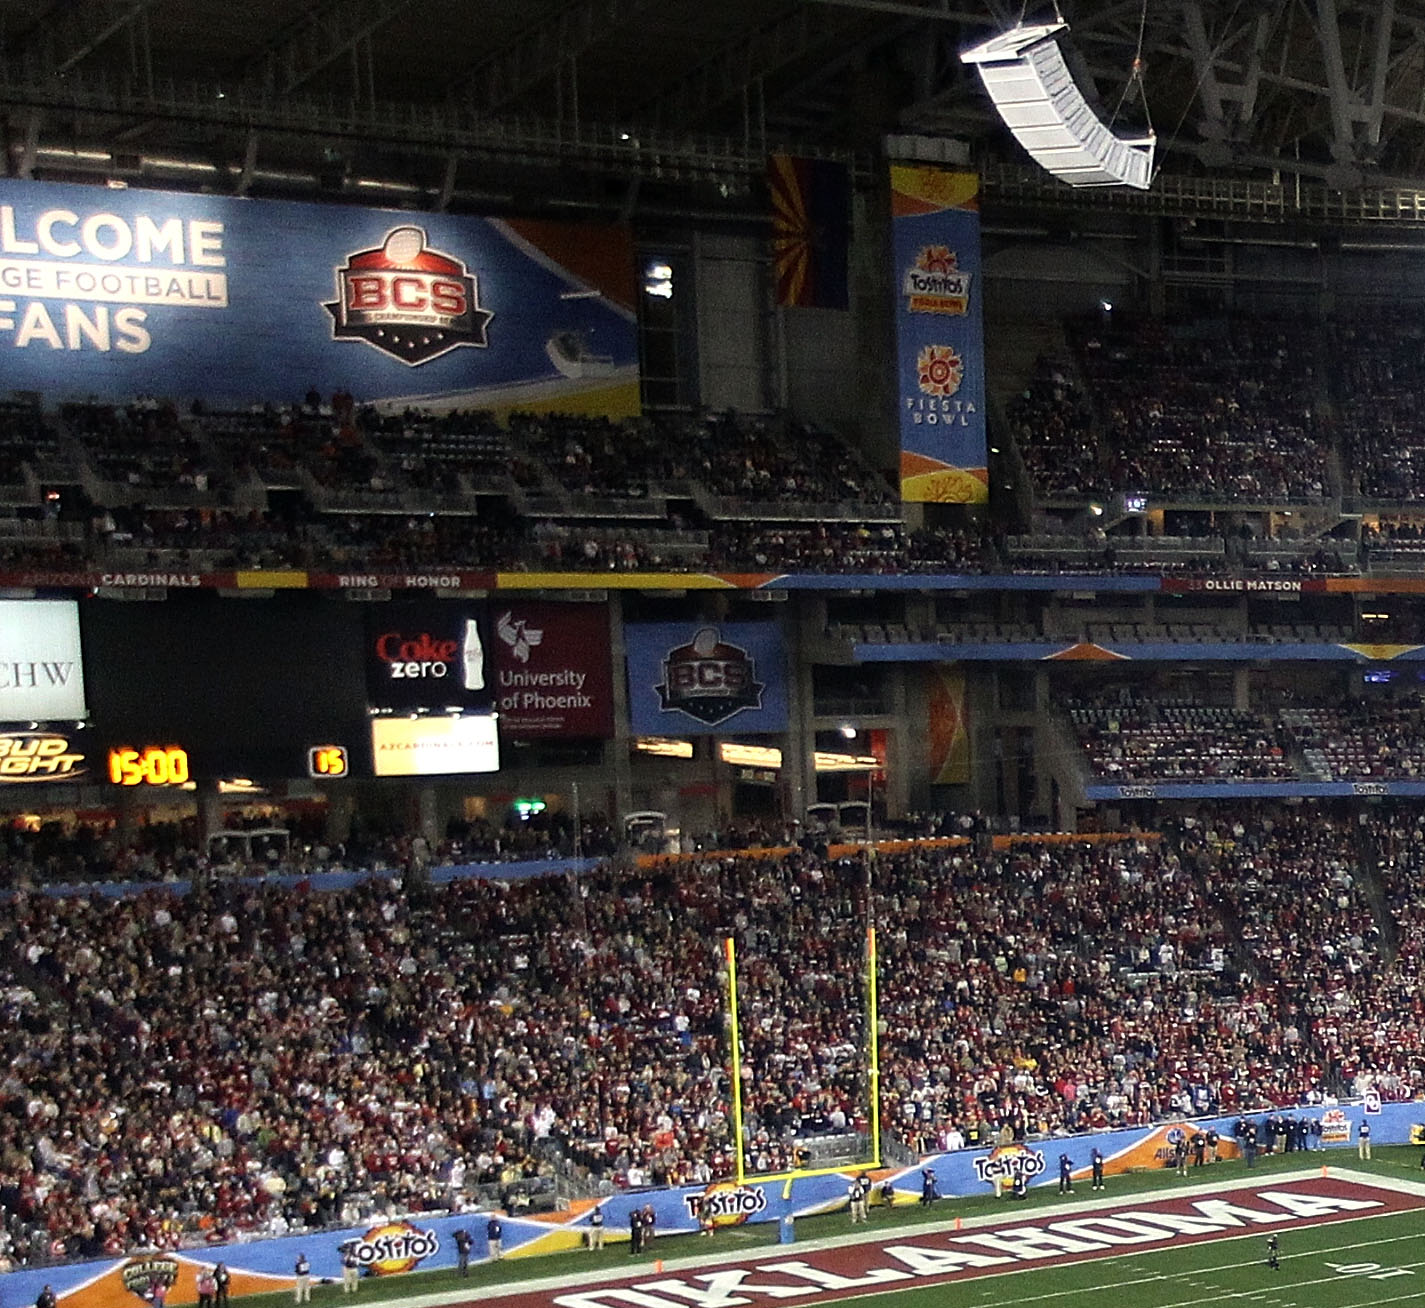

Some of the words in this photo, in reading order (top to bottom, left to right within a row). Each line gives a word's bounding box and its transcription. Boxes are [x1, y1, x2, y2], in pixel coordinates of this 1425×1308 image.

[55, 269, 222, 300] FOOTBALL
[350, 275, 467, 316] BCS
[906, 398, 977, 413] FIESTA
[912, 412, 969, 427] BOWL
[102, 574, 201, 587] CARDINALS
[338, 574, 379, 587] RING
[405, 575, 461, 588] HONOR
[1205, 580, 1244, 591] OLLIE
[1247, 581, 1302, 592] MATSON
[376, 632, 457, 662] Coke
[391, 661, 448, 679] zero
[501, 670, 587, 691] University
[502, 698, 518, 710] of
[522, 694, 592, 710] Phoenix
[111, 749, 188, 785] 15:00
[316, 748, 345, 775] 15
